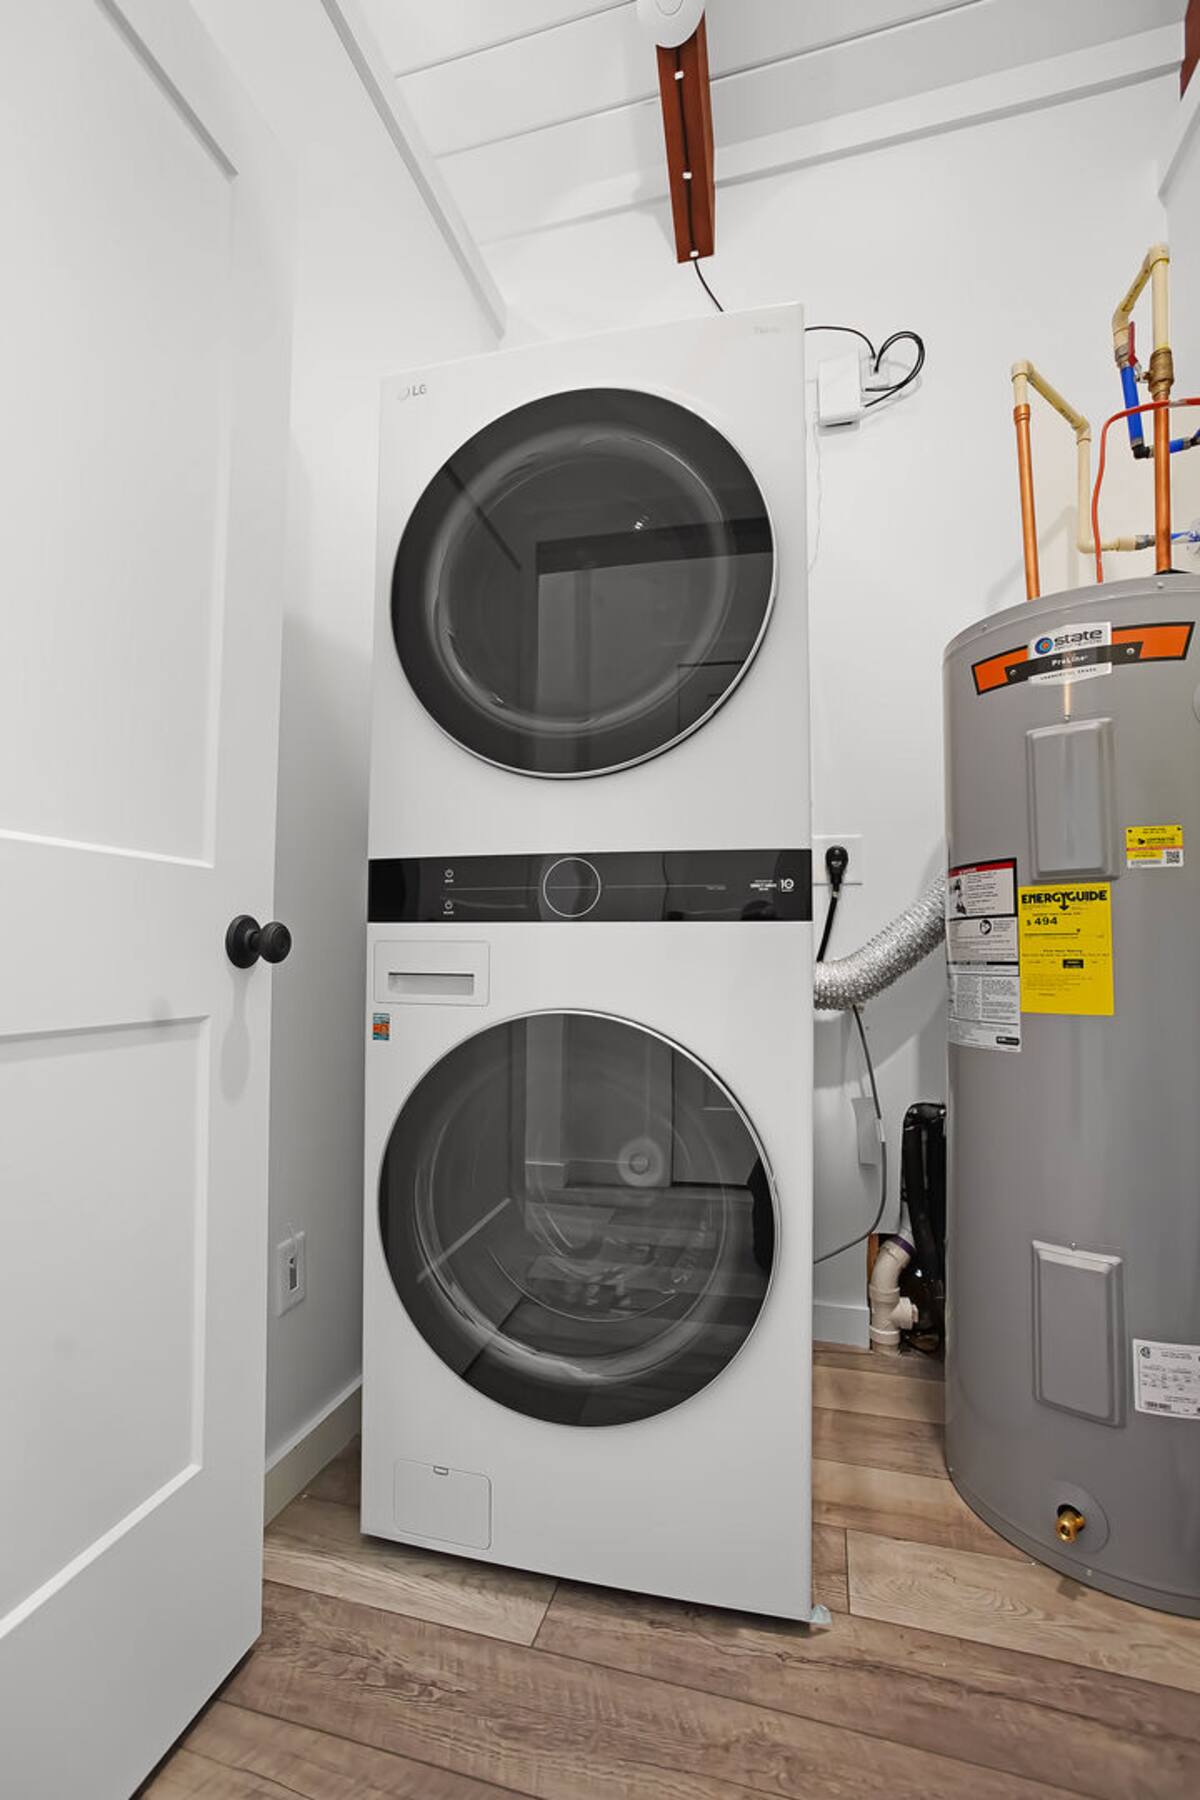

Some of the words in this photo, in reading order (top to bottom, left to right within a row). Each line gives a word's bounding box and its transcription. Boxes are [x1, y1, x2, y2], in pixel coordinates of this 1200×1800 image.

[412, 384, 428, 397] LG
[1054, 629, 1103, 646] state
[1021, 889, 1108, 905] ENERGYGUIDE
[1034, 916, 1058, 926] 494
